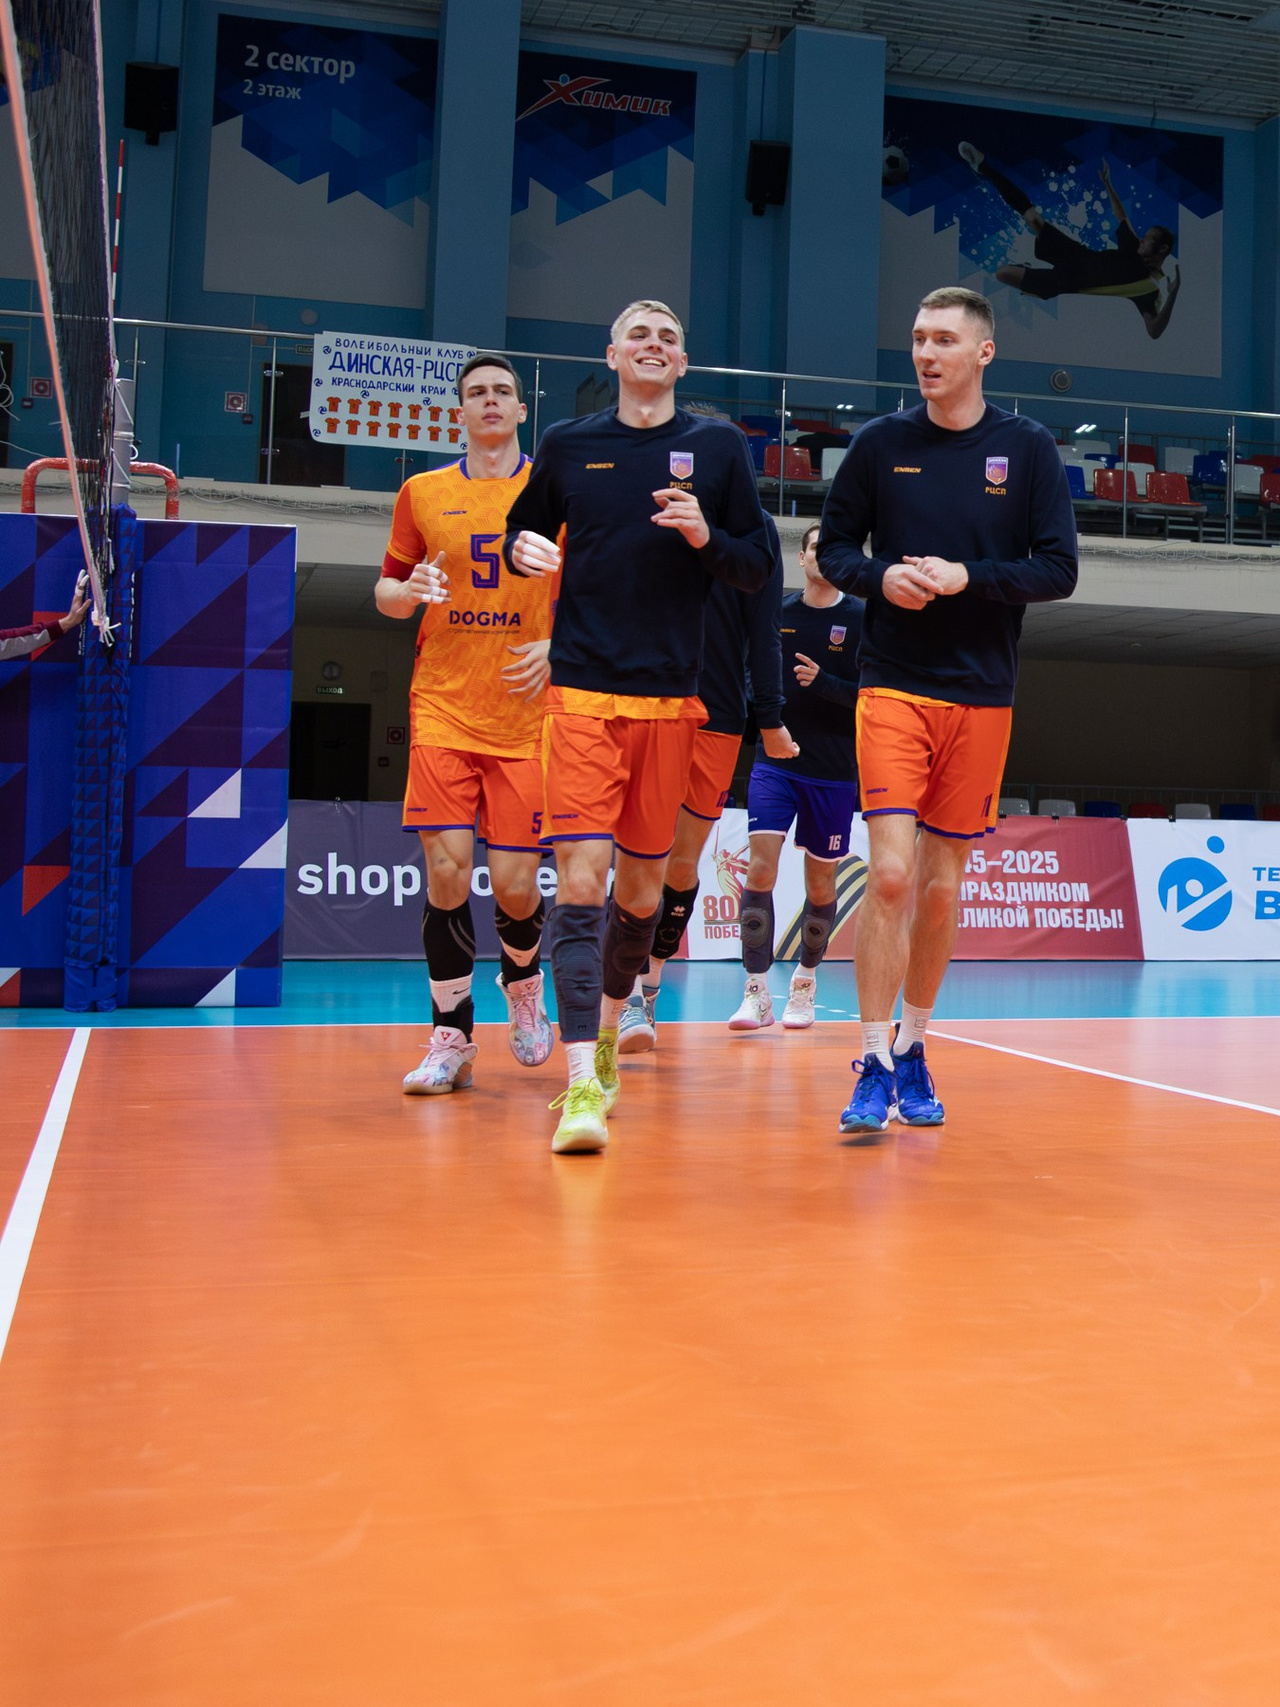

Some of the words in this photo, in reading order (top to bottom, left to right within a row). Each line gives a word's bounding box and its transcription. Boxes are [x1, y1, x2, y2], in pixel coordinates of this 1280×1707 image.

[244, 44, 260, 68] 2
[266, 51, 356, 84] сектор
[243, 79, 253, 94] 2
[257, 83, 302, 100] этаж
[438, 348, 463, 359] КЛУБ
[985, 486, 1006, 495] РЦСП
[470, 534, 503, 589] 5
[449, 610, 521, 627] DOGMA
[532, 812, 543, 834] 5
[828, 834, 842, 851] 16
[703, 895, 735, 920] 80
[957, 905, 1030, 928] ЛИКОЙ
[1034, 908, 1124, 932] ПОБЕДЫ!
[704, 925, 741, 939] ПОБЕ
